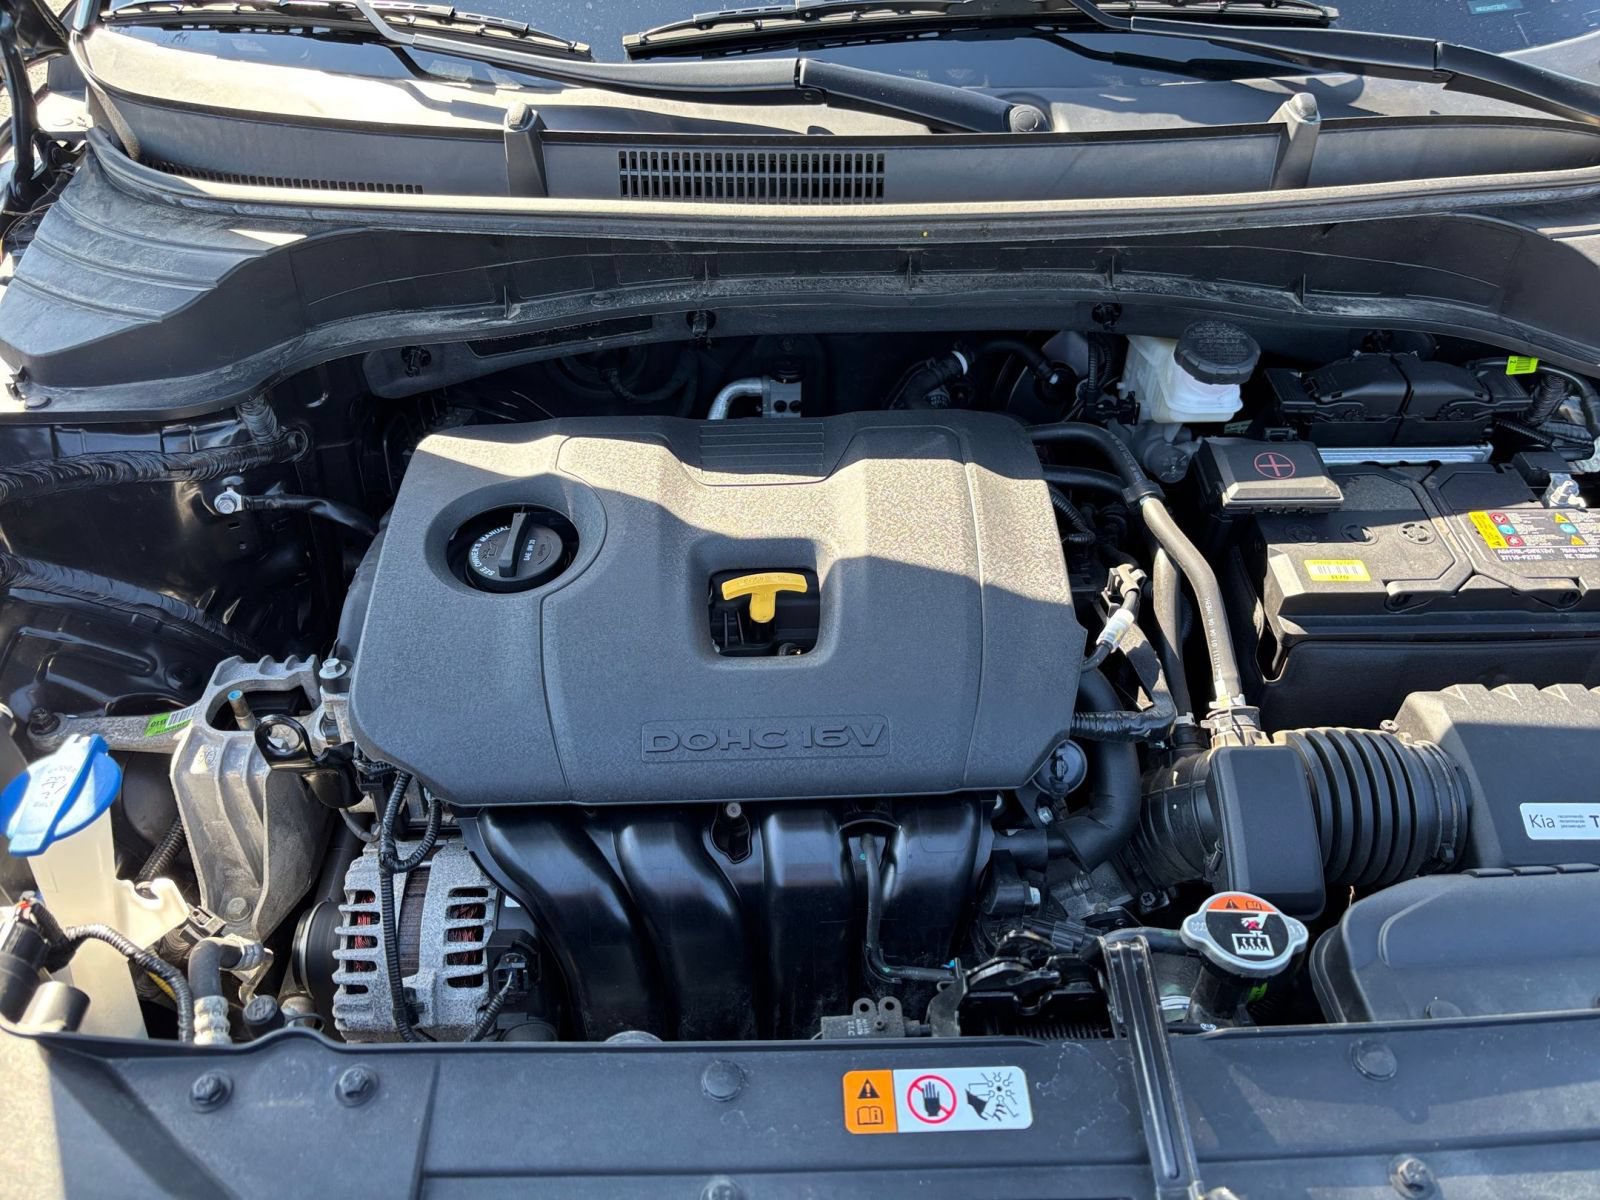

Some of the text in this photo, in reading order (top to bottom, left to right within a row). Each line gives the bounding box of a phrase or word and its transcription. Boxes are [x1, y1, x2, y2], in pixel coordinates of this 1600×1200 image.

[479, 525, 511, 542] MANUAL
[480, 566, 495, 576] SEE
[645, 722, 886, 754] DOHC 16V
[1528, 814, 1556, 828] Kia
